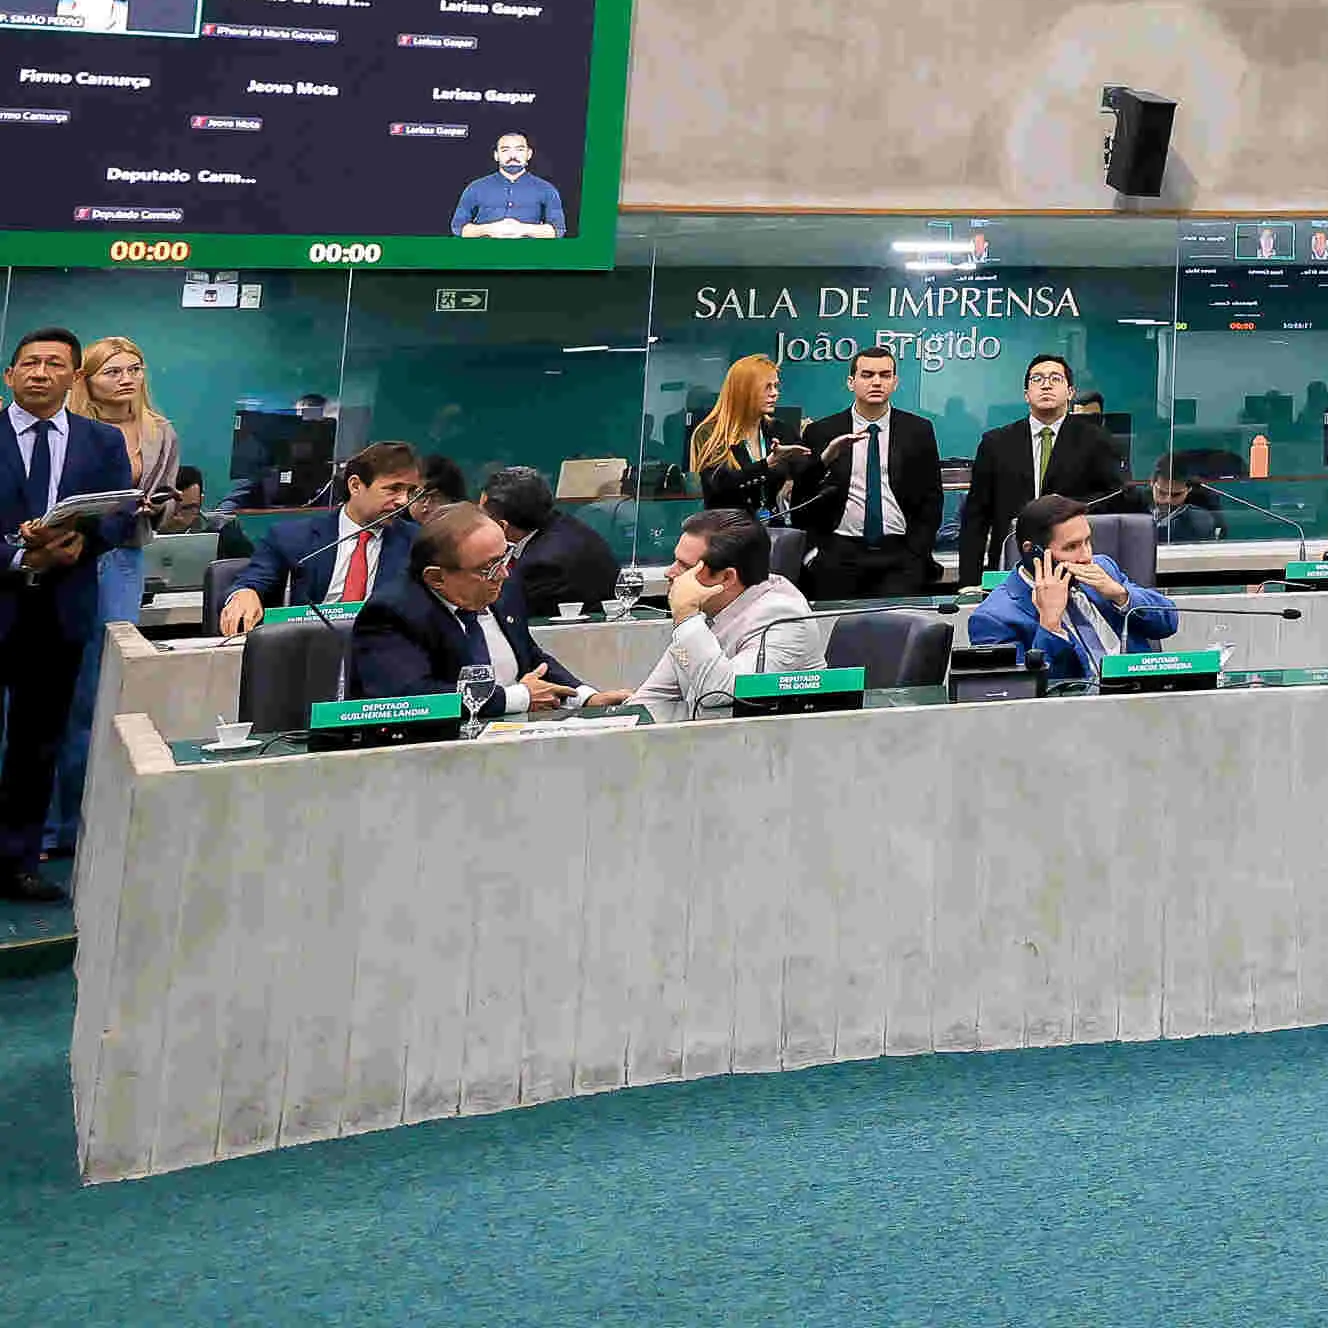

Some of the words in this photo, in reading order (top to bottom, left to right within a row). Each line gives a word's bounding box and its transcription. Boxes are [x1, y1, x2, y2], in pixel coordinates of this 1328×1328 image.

[439, 0, 489, 14] Larissa
[491, 2, 543, 18] Gaspar
[20, 68, 72, 84] Firmo
[75, 72, 151, 90] Camurça
[296, 81, 339, 96] Mota
[432, 87, 482, 101] Larissa
[485, 89, 537, 105] Gaspar
[106, 167, 191, 183] Deputado
[92, 209, 139, 220] Deputado
[110, 240, 191, 262] 00:00
[309, 243, 382, 263] 00:00
[695, 286, 798, 319] SALA
[818, 286, 871, 318] DE
[888, 286, 1081, 318] IMPRENSA
[775, 329, 858, 365] João
[874, 326, 1001, 372] Brígido
[340, 709, 393, 721] GUILHERME
[393, 707, 430, 718] LANDIM
[362, 701, 410, 712] DEPUTADO
